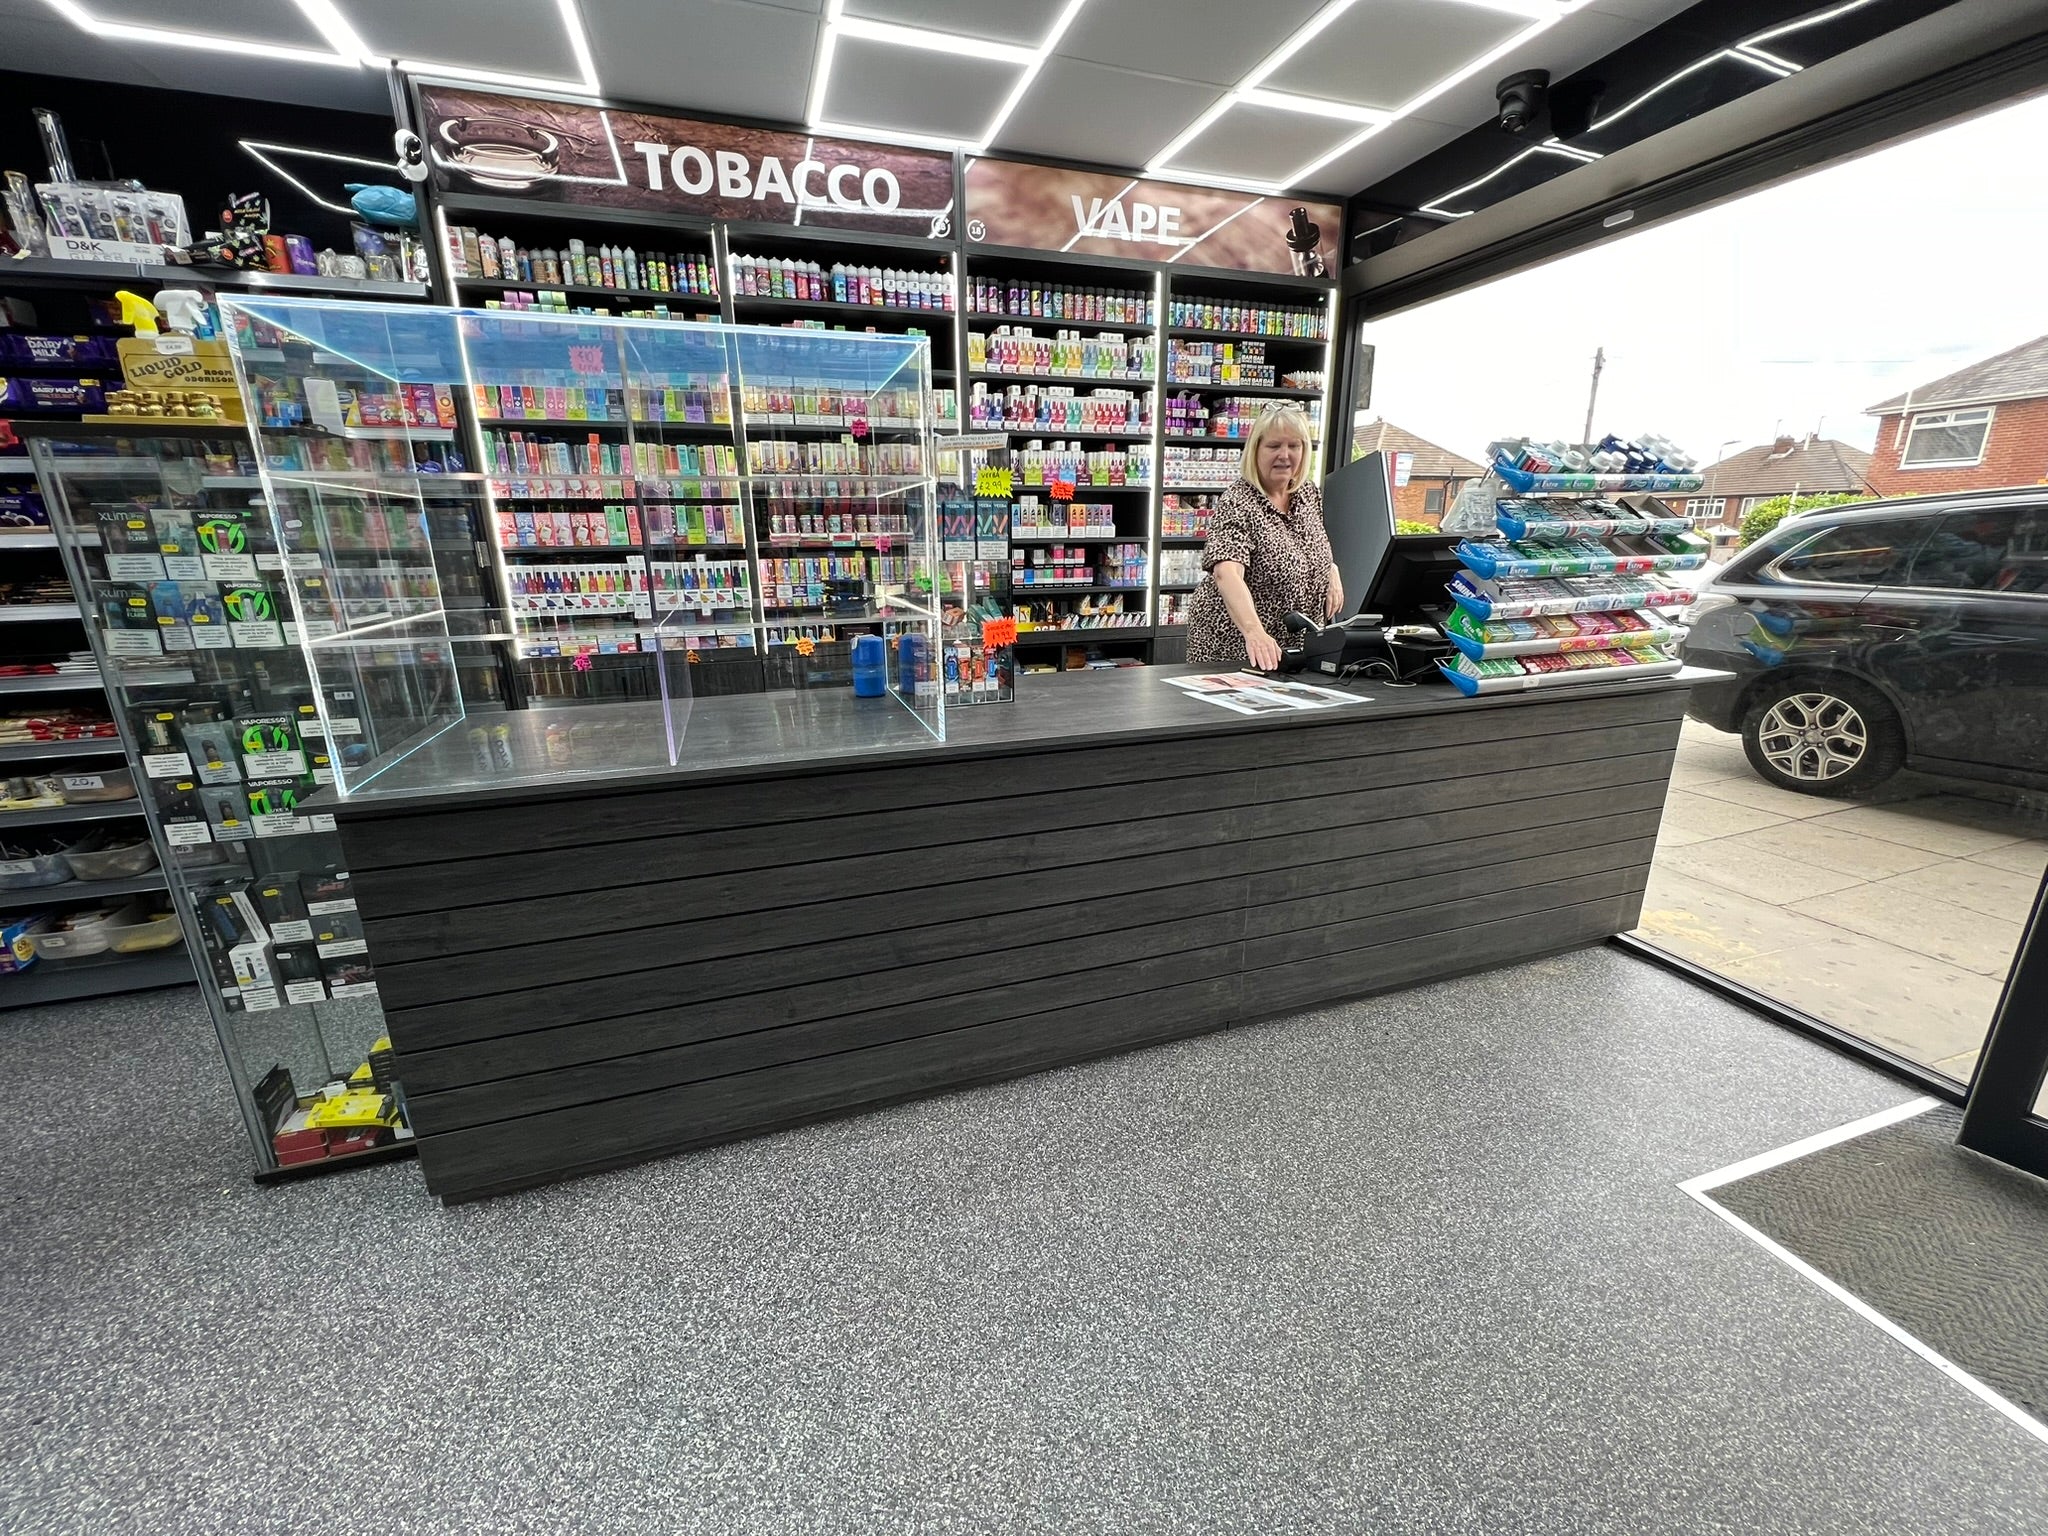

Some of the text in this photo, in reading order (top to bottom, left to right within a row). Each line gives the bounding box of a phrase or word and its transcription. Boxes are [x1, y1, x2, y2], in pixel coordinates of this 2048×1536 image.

[634, 141, 900, 213] TOBACCO
[1071, 195, 1181, 246] VAPE
[66, 240, 101, 251] D&K
[28, 340, 62, 349] DAIRY
[32, 349, 61, 357] MILK
[129, 356, 181, 378] LIQUID
[163, 361, 202, 379] GOLD
[240, 717, 286, 725] VAPORESSO
[248, 779, 293, 787] VAPORESSO
